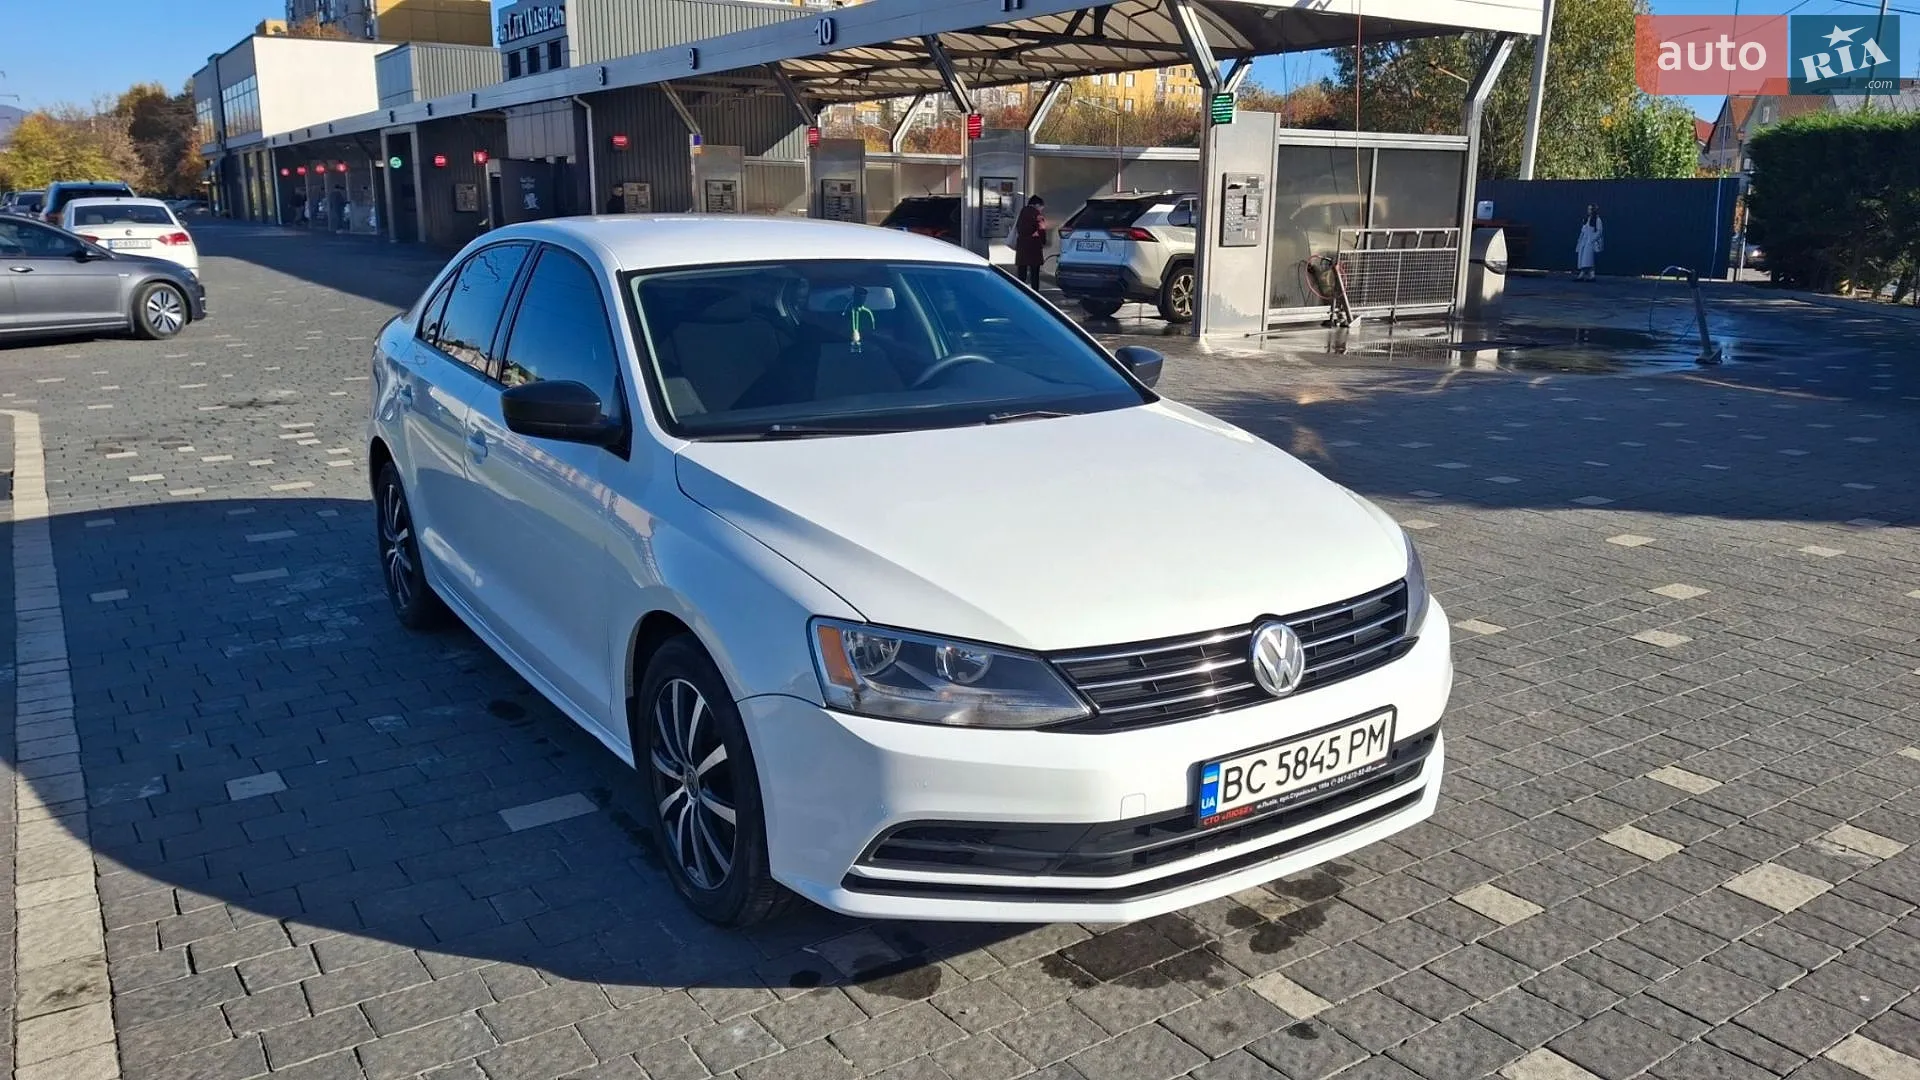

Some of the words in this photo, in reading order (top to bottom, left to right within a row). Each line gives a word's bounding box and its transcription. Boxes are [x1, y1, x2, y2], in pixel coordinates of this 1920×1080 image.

[524, 6, 549, 36] WASH
[814, 17, 836, 45] 10
[688, 47, 699, 69] 9
[595, 66, 606, 85] 8
[1222, 758, 1267, 803] BC
[1276, 735, 1341, 786] 5845
[1348, 718, 1387, 764] PM
[1201, 797, 1216, 810] UA
